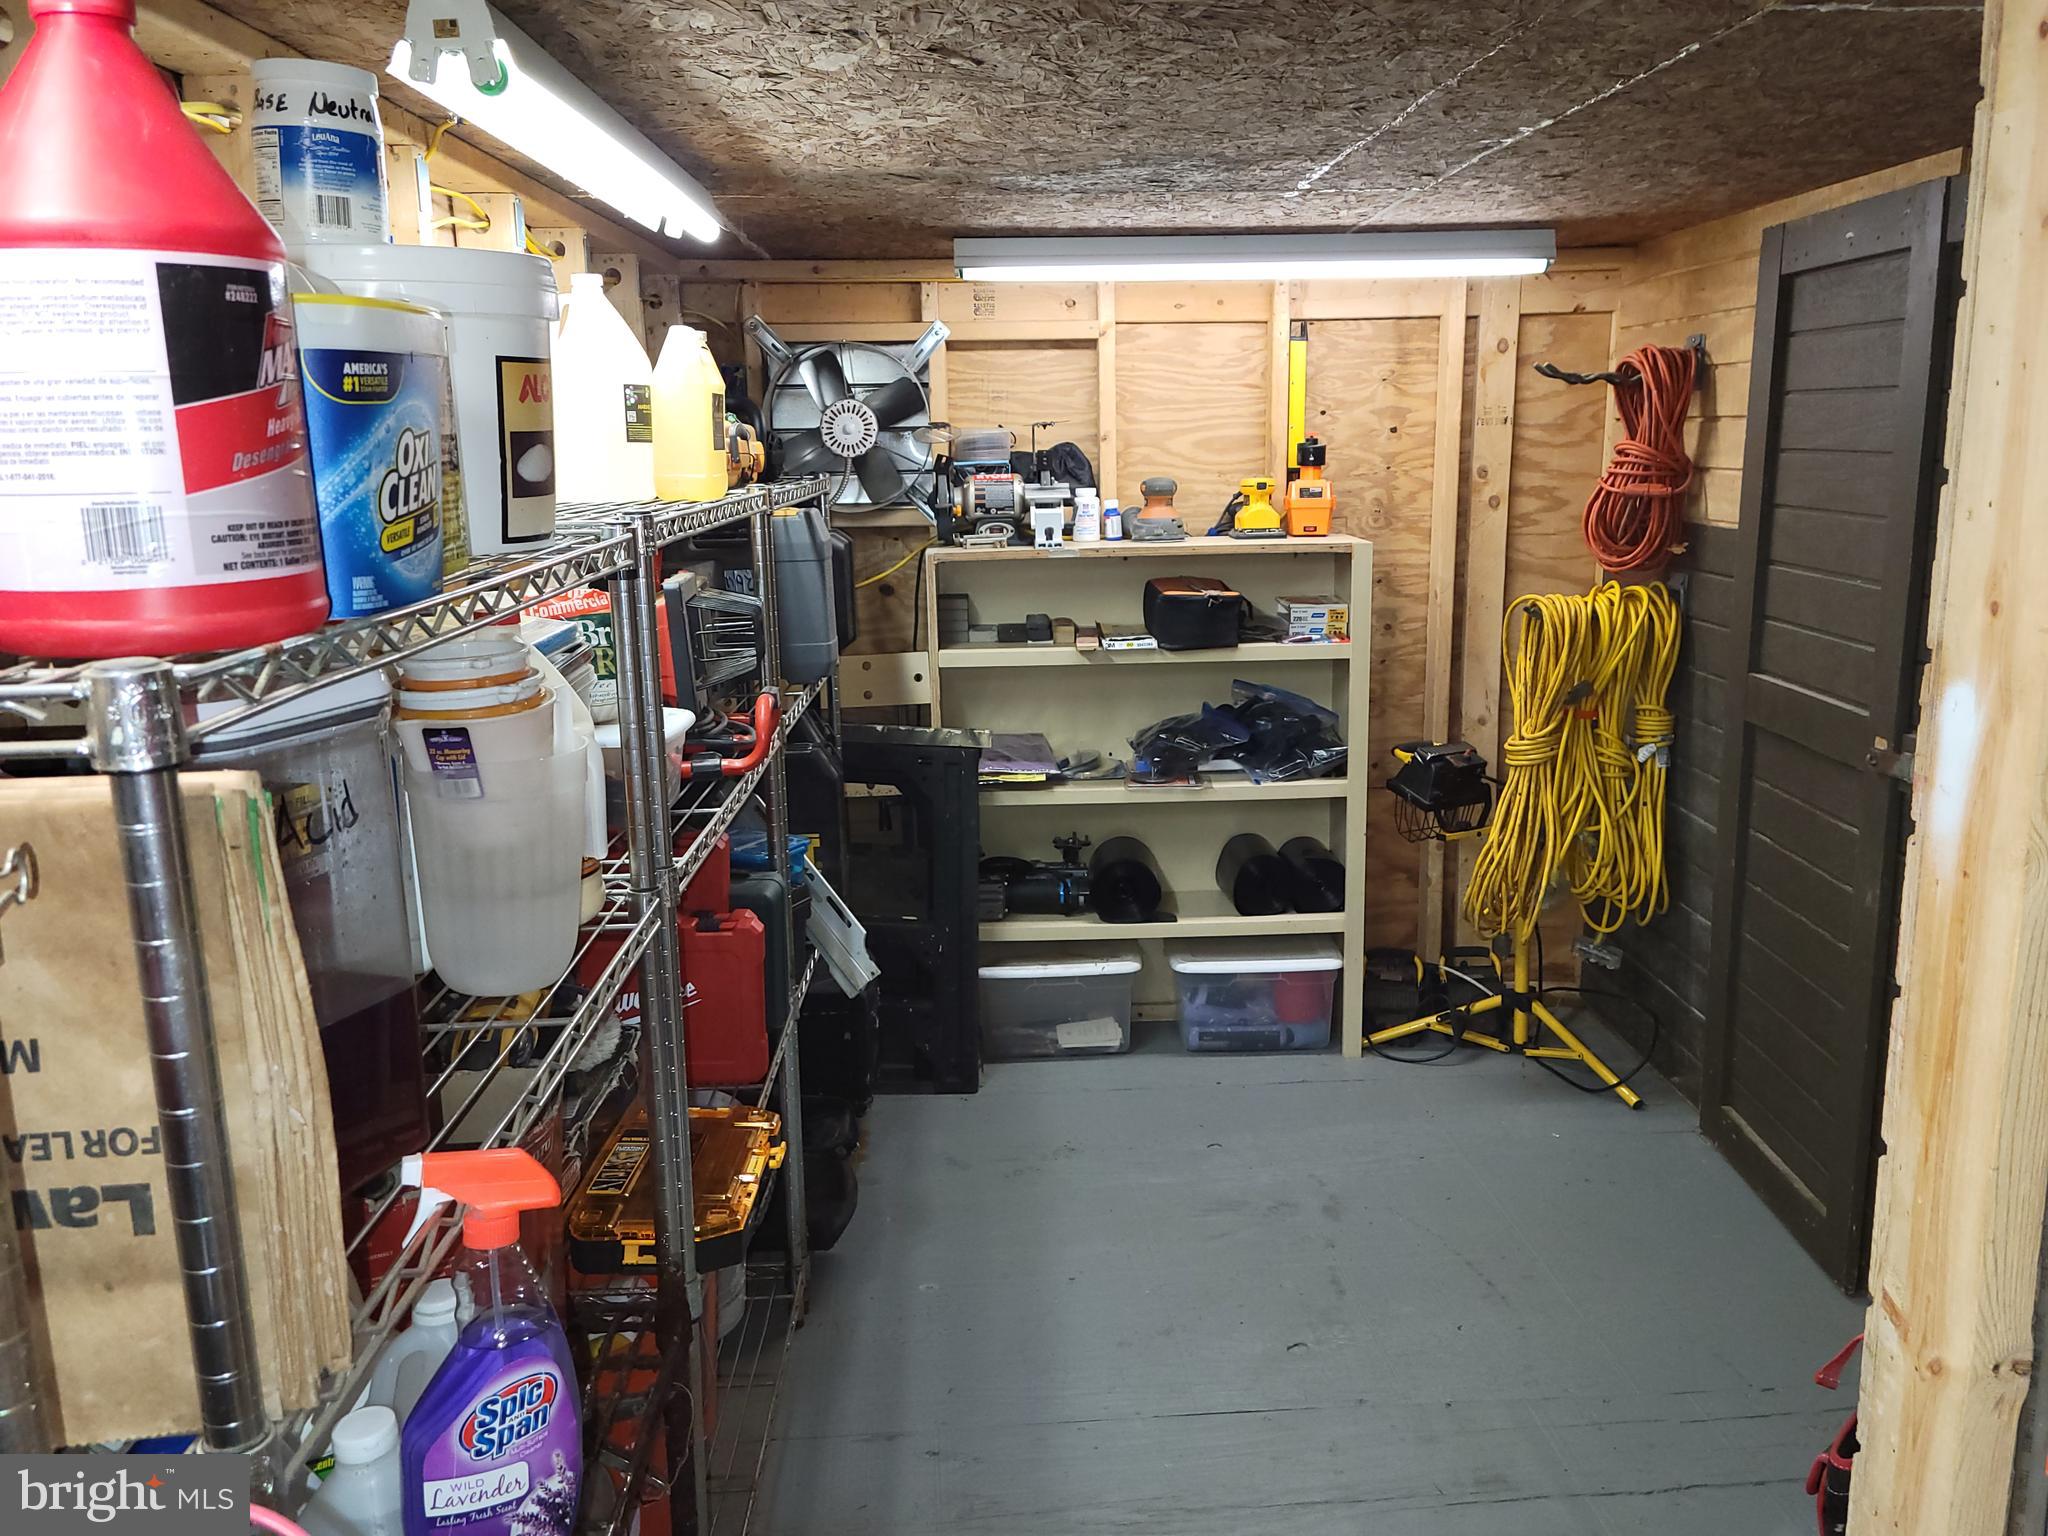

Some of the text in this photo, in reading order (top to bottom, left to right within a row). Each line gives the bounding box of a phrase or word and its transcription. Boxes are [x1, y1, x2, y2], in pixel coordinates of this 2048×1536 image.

[308, 91, 373, 123] Neutra
[343, 362, 388, 375] AMERICA'S
[343, 376, 359, 392] #1
[397, 429, 430, 477] OXI
[381, 464, 437, 522] CLEAN
[211, 533, 248, 543] CAUTION:
[224, 562, 238, 571] NET
[240, 559, 279, 570] CONTENTS:
[529, 593, 609, 617] Commercia
[578, 620, 614, 648] Br
[81, 1126, 162, 1159] FOR
[475, 1382, 545, 1430] Spic
[508, 1412, 527, 1424] AND
[470, 1402, 550, 1460] Span
[430, 1473, 527, 1511] Lavender
[450, 1478, 485, 1493] WILD
[436, 1502, 518, 1528] Lasting Fresh Scent
